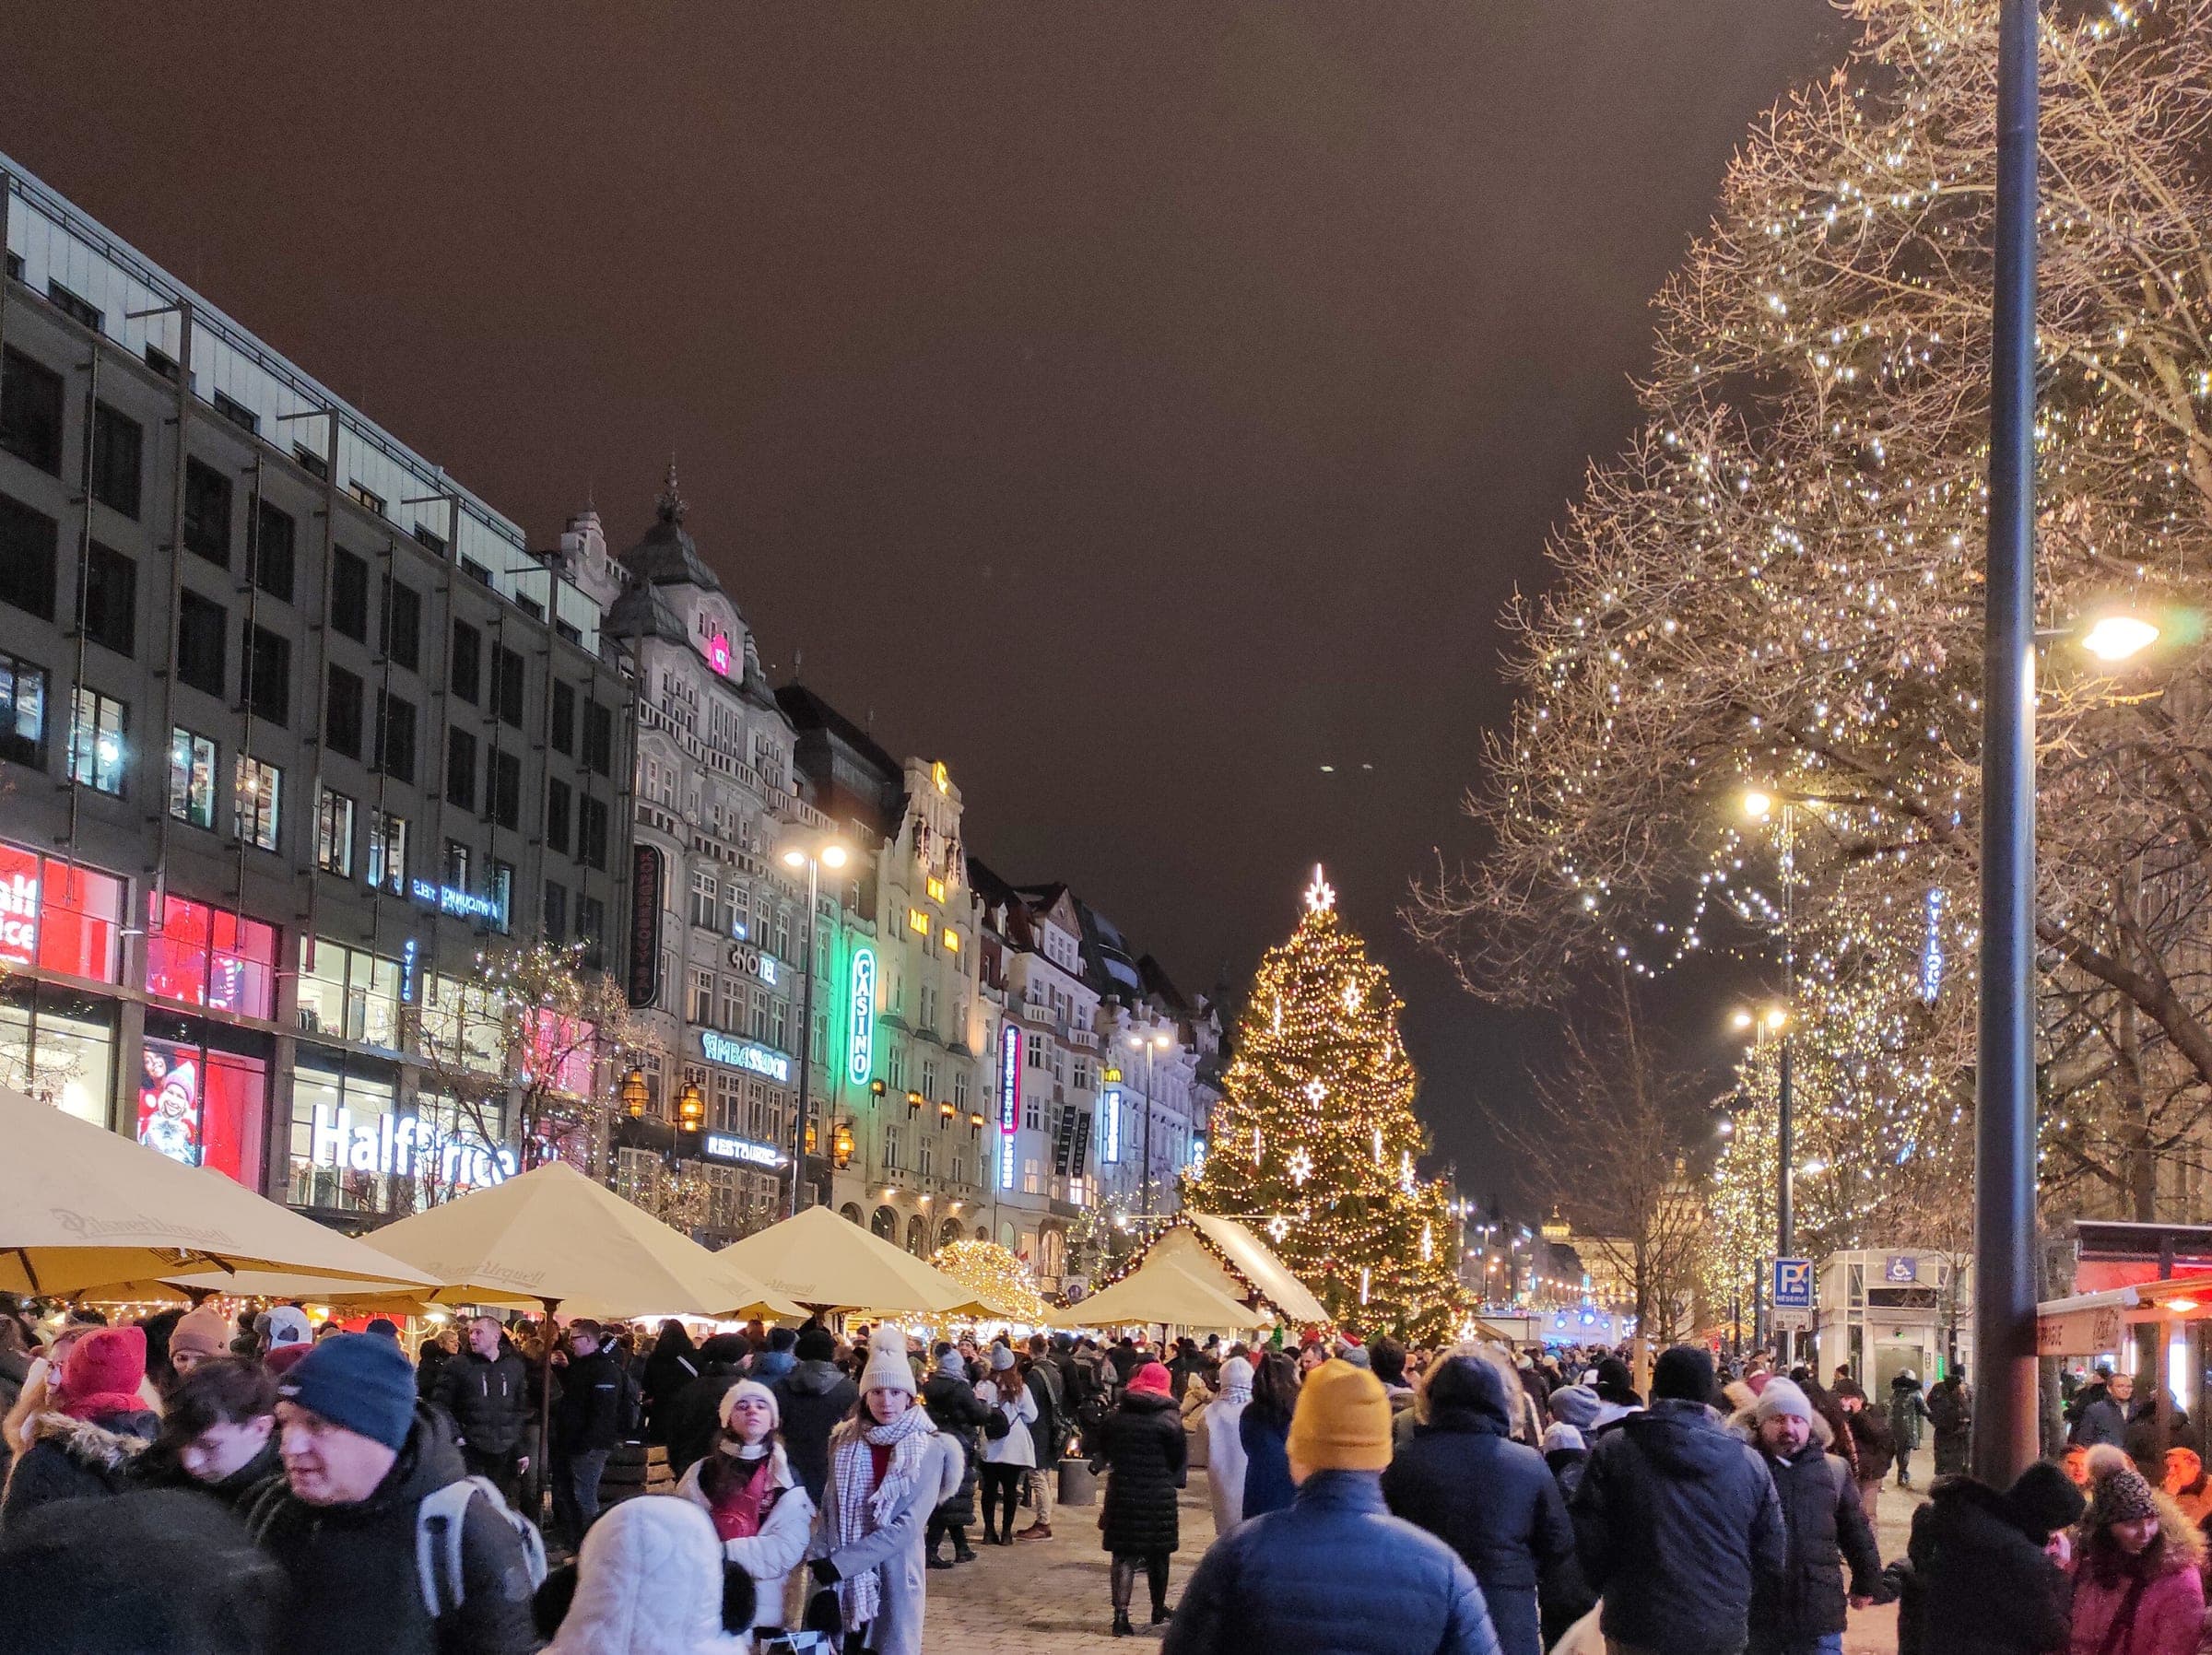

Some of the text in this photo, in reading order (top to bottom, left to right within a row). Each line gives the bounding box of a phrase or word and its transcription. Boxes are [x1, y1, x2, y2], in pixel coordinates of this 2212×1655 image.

[853, 959, 870, 1073] CASINO
[702, 1033, 787, 1081] AMBASSADOR
[1073, 1121, 1088, 1175] RESERVED
